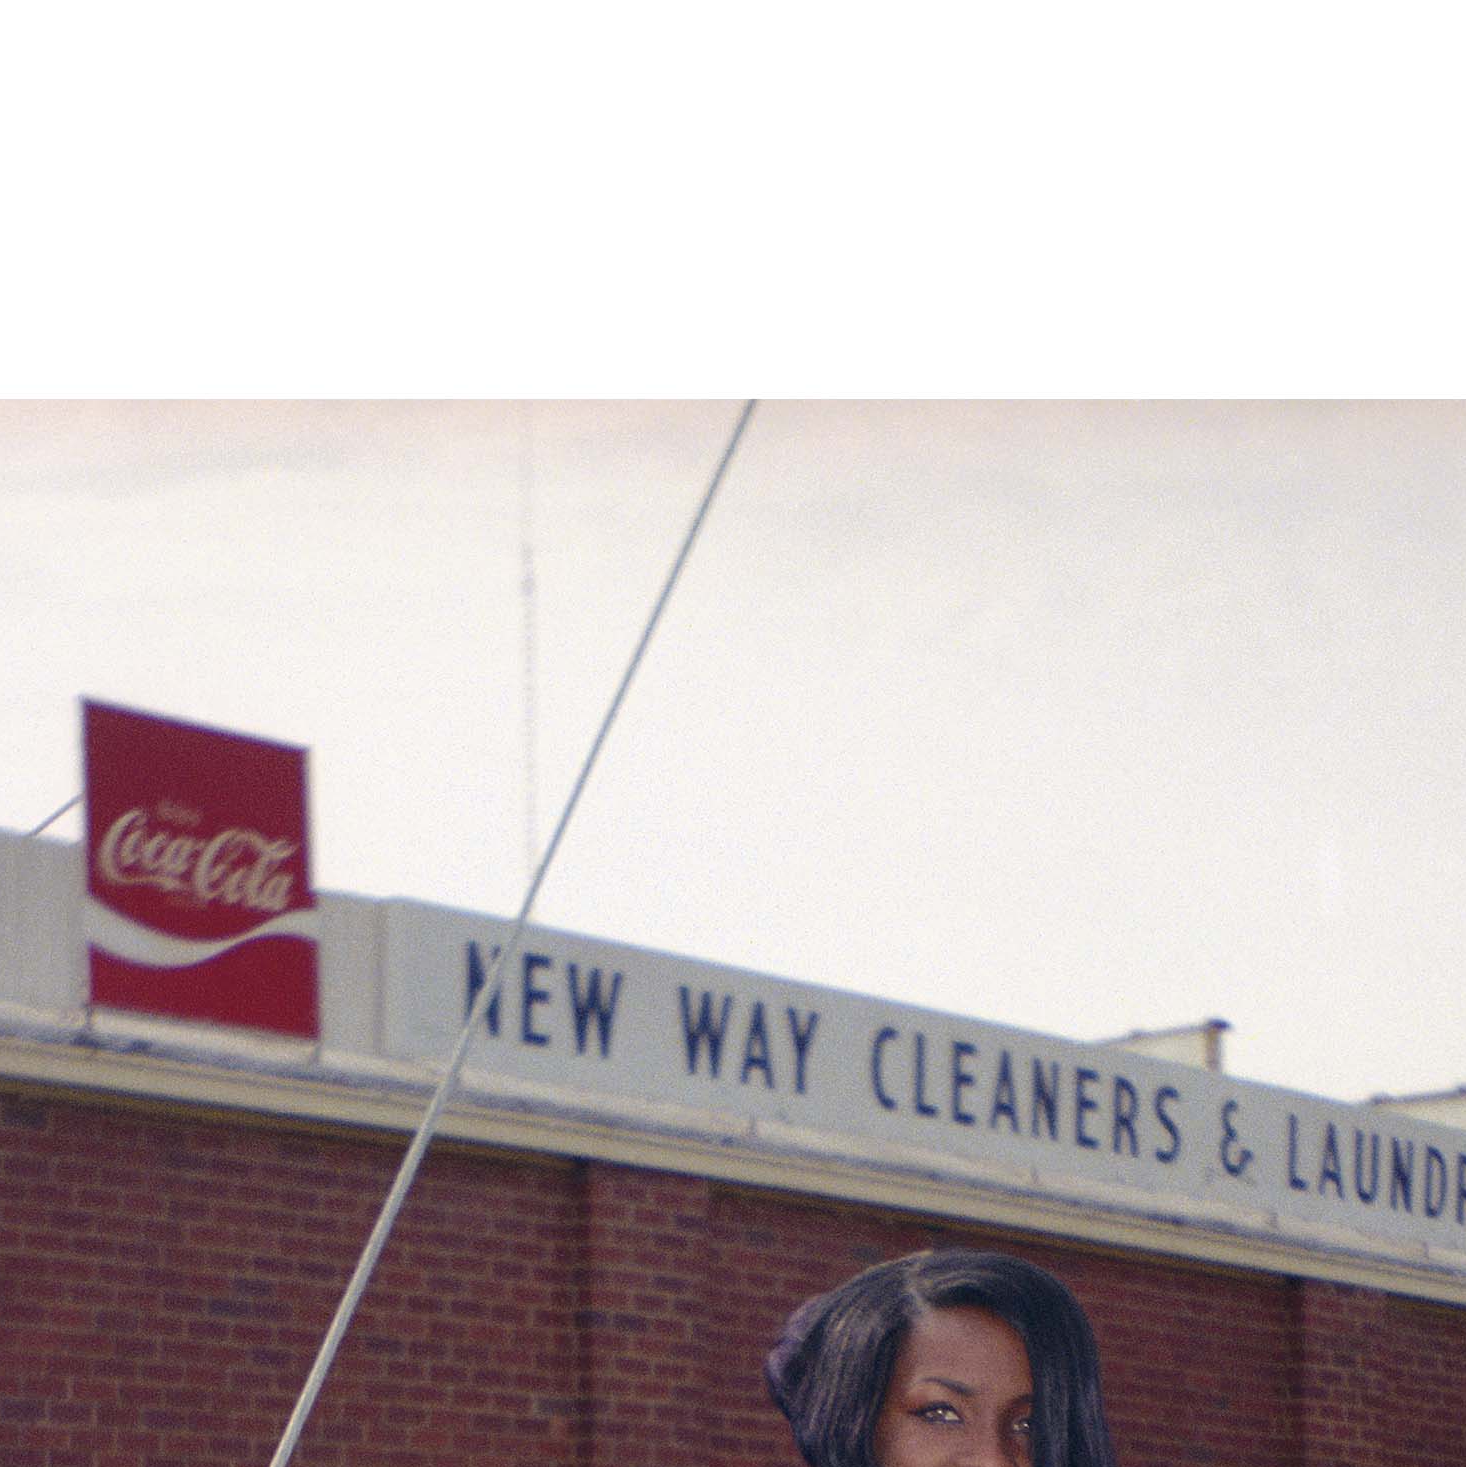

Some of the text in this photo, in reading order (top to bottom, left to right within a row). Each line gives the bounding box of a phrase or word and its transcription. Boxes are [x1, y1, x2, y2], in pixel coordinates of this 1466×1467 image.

[99, 807, 299, 912] Coca-Cola
[464, 939, 623, 1059] NEW
[679, 984, 821, 1095] WAY
[869, 1025, 1183, 1164] CLEANERS
[1219, 1099, 1254, 1177] &
